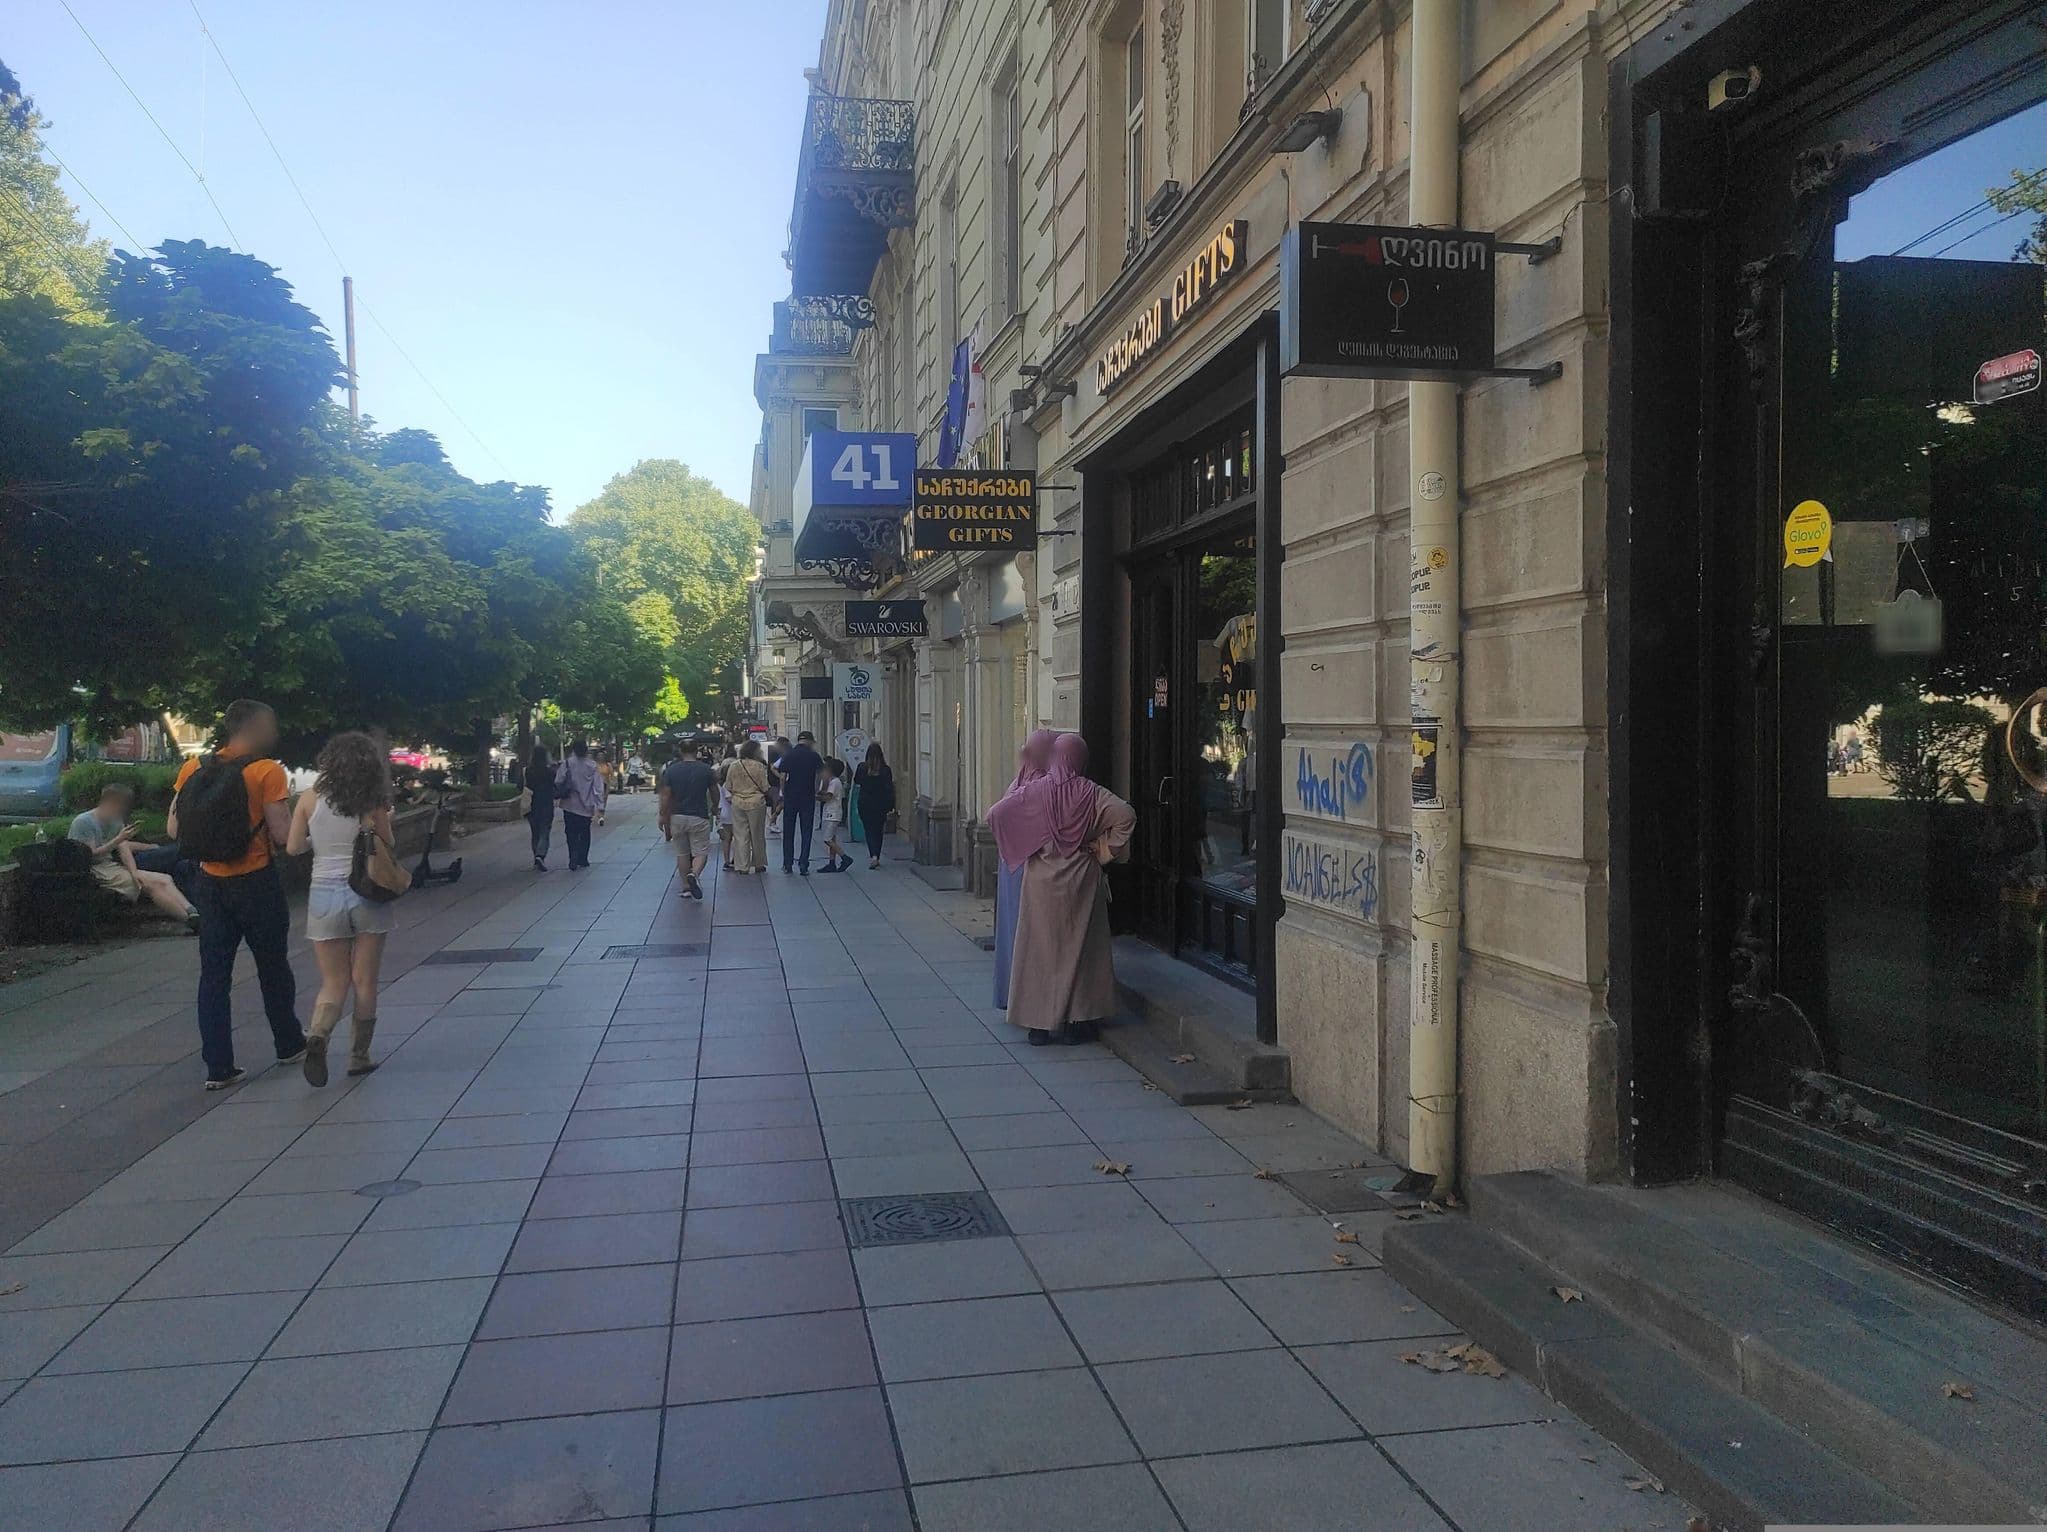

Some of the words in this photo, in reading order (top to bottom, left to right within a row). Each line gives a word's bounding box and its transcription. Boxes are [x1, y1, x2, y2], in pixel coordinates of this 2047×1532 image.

[1380, 236, 1487, 270] ღვინო
[1171, 221, 1238, 322] GIFTS
[831, 444, 899, 490] 41
[917, 477, 1031, 497] საჩუქრები
[917, 504, 1032, 521] GEORGIAN
[949, 528, 1013, 543] GIFTS
[1789, 529, 1822, 543] Glovo
[849, 622, 923, 634] SWAROVSKI
